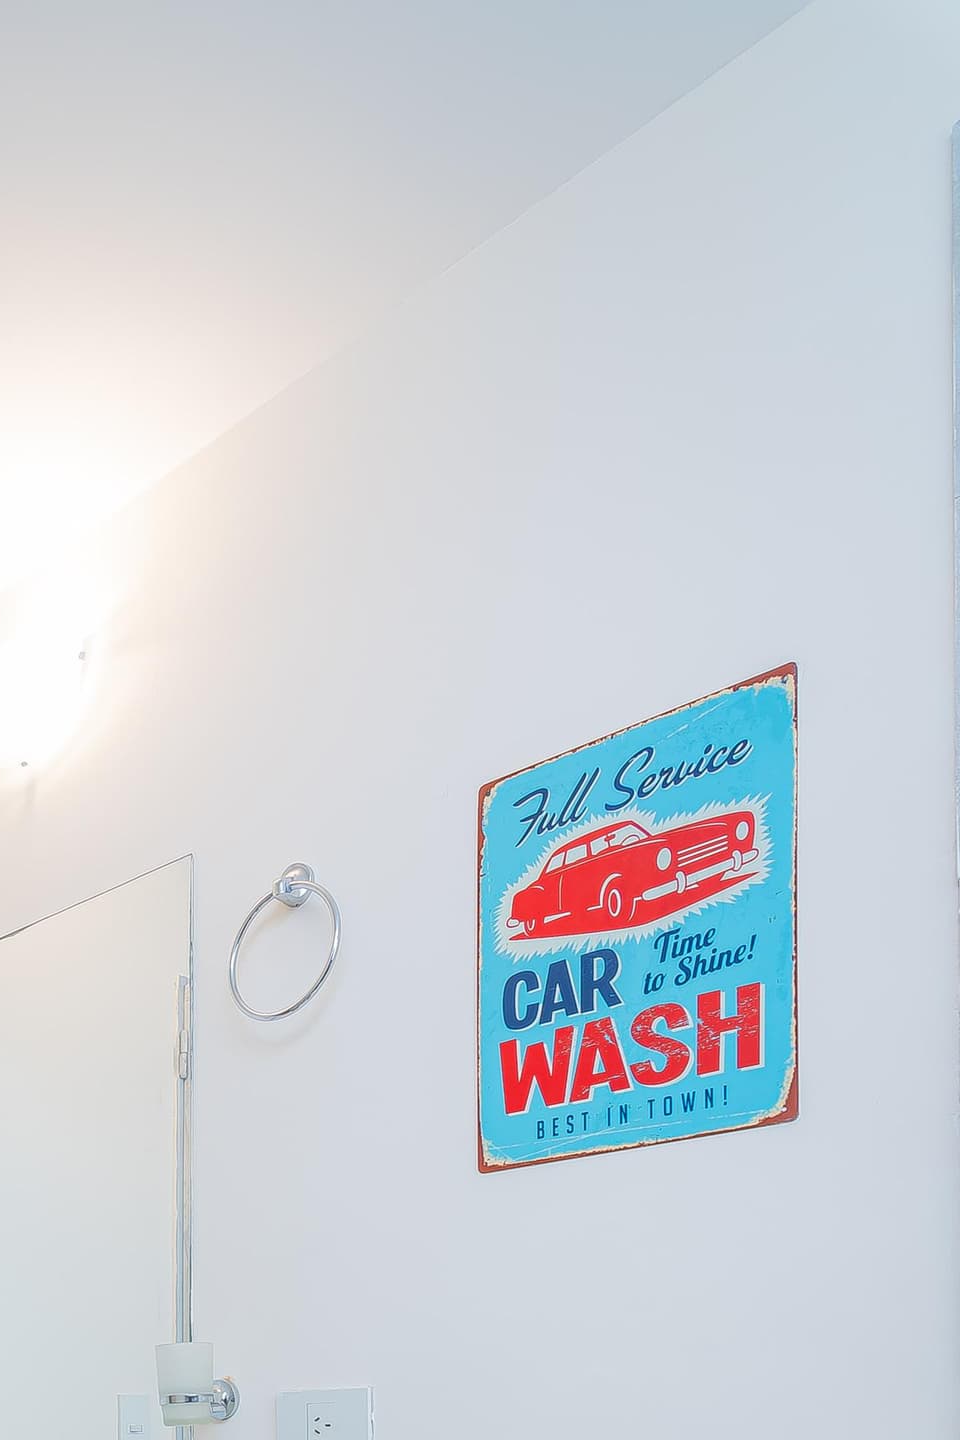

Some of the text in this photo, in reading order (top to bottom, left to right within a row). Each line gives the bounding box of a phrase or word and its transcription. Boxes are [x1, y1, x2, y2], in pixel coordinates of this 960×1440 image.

[513, 739, 752, 847] Full Service
[643, 935, 756, 994] to Shine!
[653, 928, 716, 963] Time
[502, 948, 622, 1030] CAR
[499, 982, 763, 1115] WASH
[537, 1085, 728, 1139] BEST IN TOWN!
